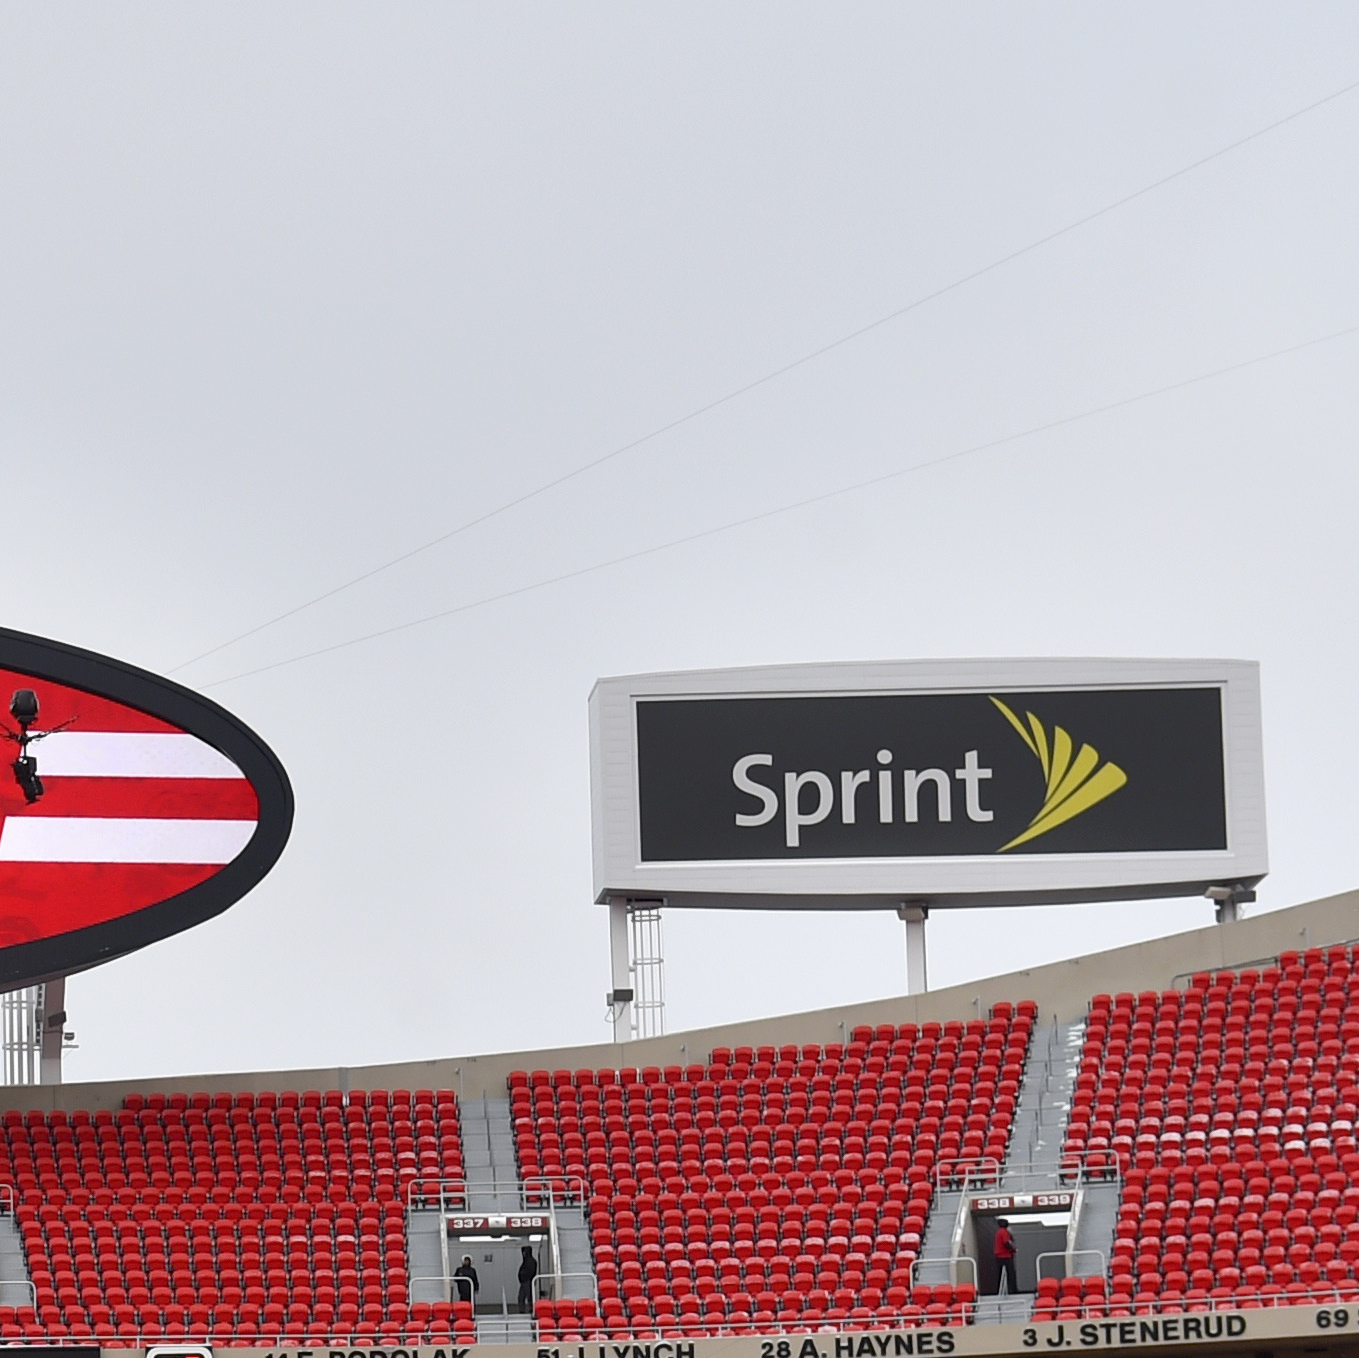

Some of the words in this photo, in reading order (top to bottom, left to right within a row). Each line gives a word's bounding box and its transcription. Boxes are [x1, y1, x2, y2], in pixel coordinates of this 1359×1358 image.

[731, 749, 994, 848] Sprint
[977, 1198, 1010, 1209] 338
[1037, 1194, 1070, 1206] 339
[453, 1218, 484, 1229] 337
[510, 1217, 543, 1228] 338
[1315, 1310, 1349, 1329] 69
[1022, 1328, 1038, 1348] 3
[1044, 1325, 1073, 1348] J.
[1078, 1314, 1248, 1347] STENERUD
[835, 1331, 956, 1358] HAYNES
